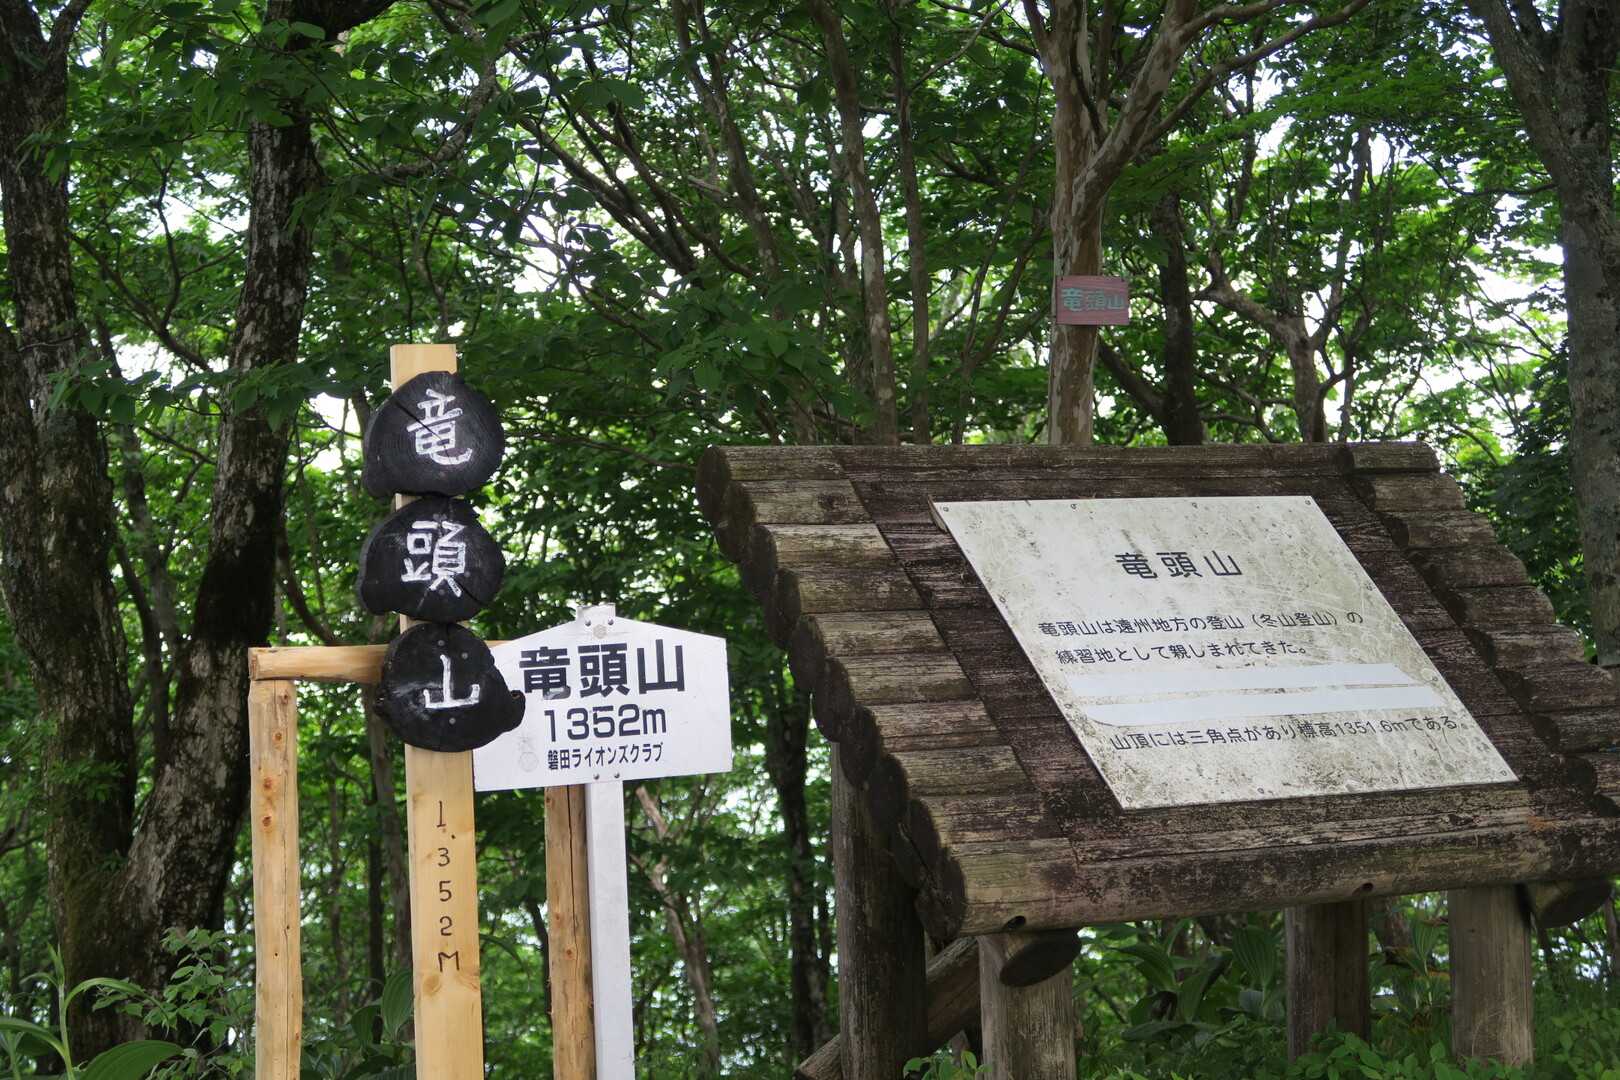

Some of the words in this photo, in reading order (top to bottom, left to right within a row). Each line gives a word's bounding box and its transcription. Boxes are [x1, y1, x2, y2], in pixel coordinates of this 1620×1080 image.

[1061, 287, 1125, 312] 竜頭山
[401, 388, 481, 709] 竜頭山
[1114, 550, 1243, 579] 竜頭山
[519, 639, 686, 700] 竜頭山
[544, 703, 667, 742] 1352m
[547, 741, 664, 771] 磐田ライオンズクラブ
